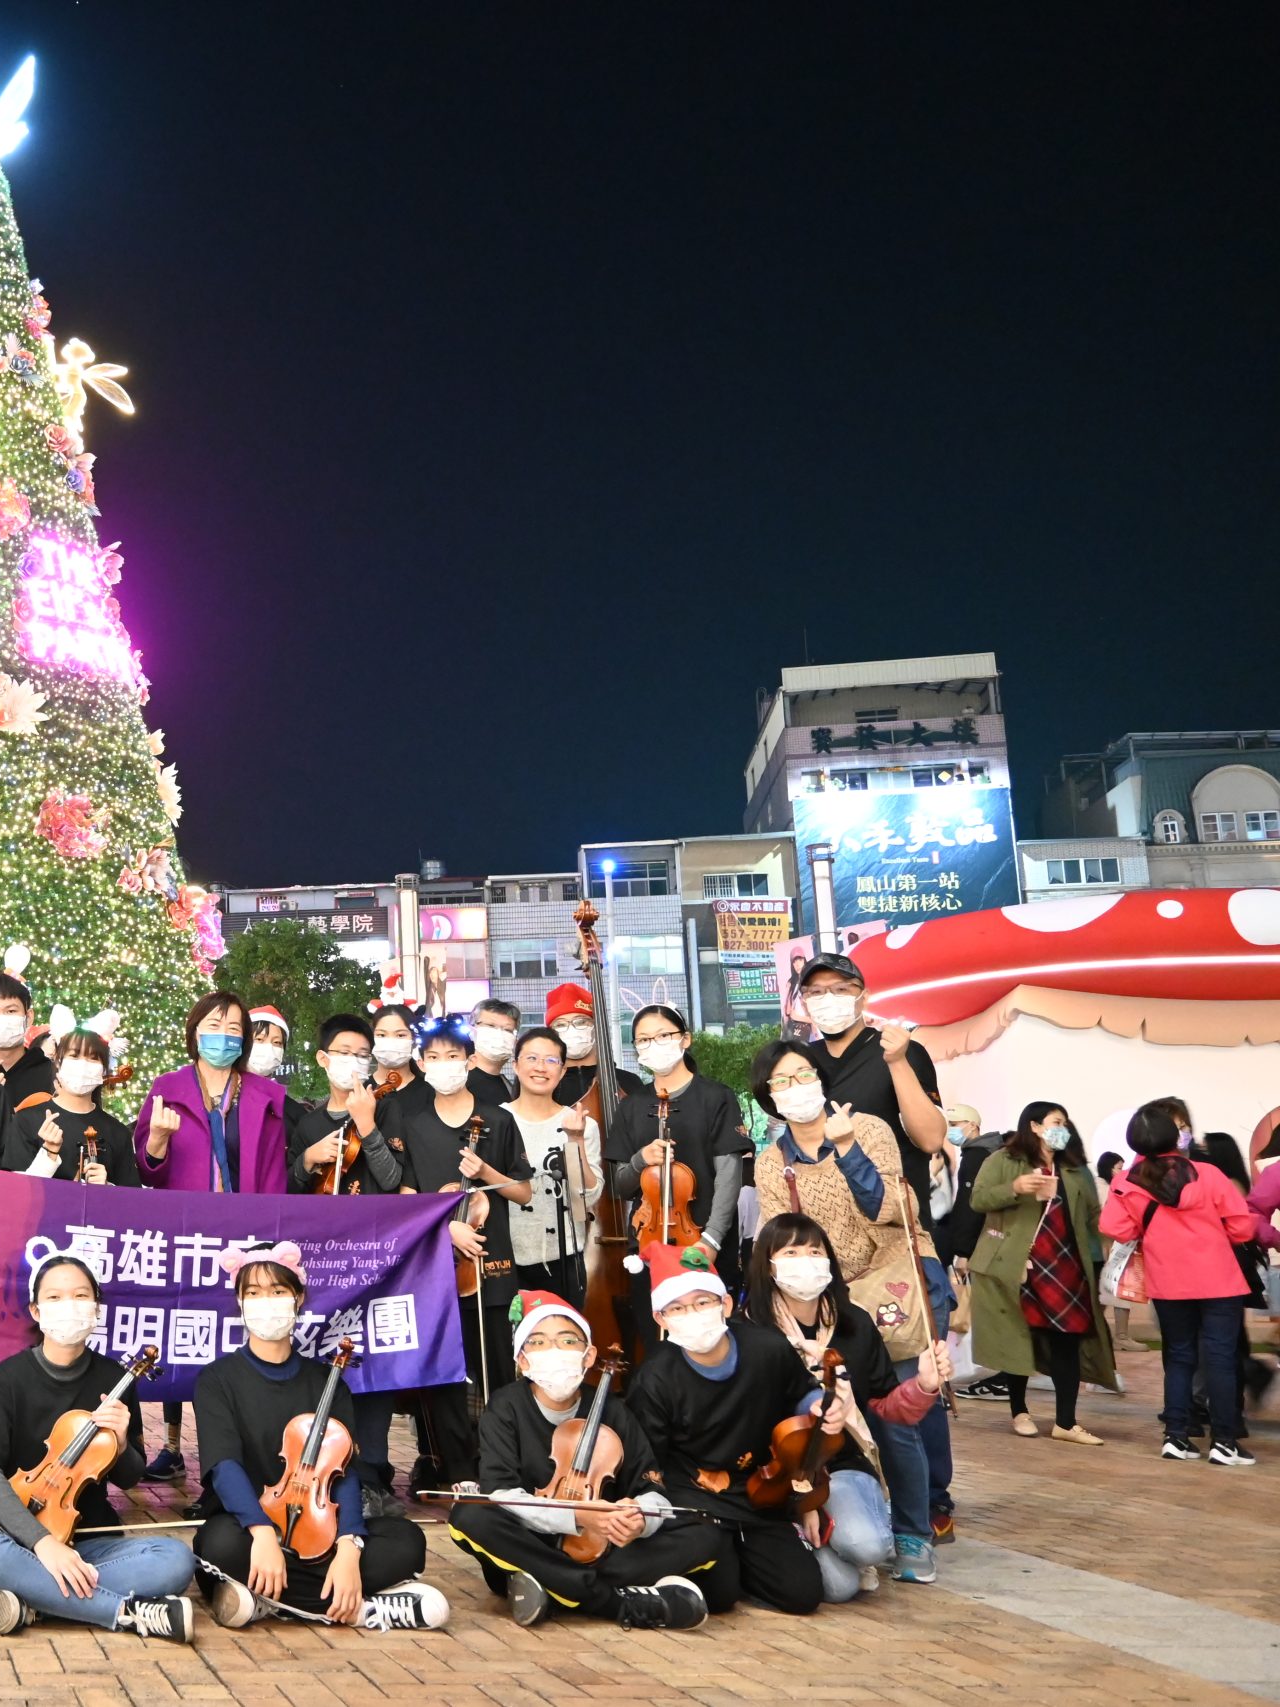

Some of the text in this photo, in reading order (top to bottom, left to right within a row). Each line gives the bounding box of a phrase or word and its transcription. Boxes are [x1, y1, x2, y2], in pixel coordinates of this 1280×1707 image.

[856, 872, 960, 893] 鳳山第一站
[857, 894, 962, 914] 雙捷新核心
[324, 1239, 380, 1252] Orchestra
[384, 1237, 398, 1253] of
[299, 1254, 401, 1271] ohsiung Yang-Mi
[327, 1274, 356, 1289] High
